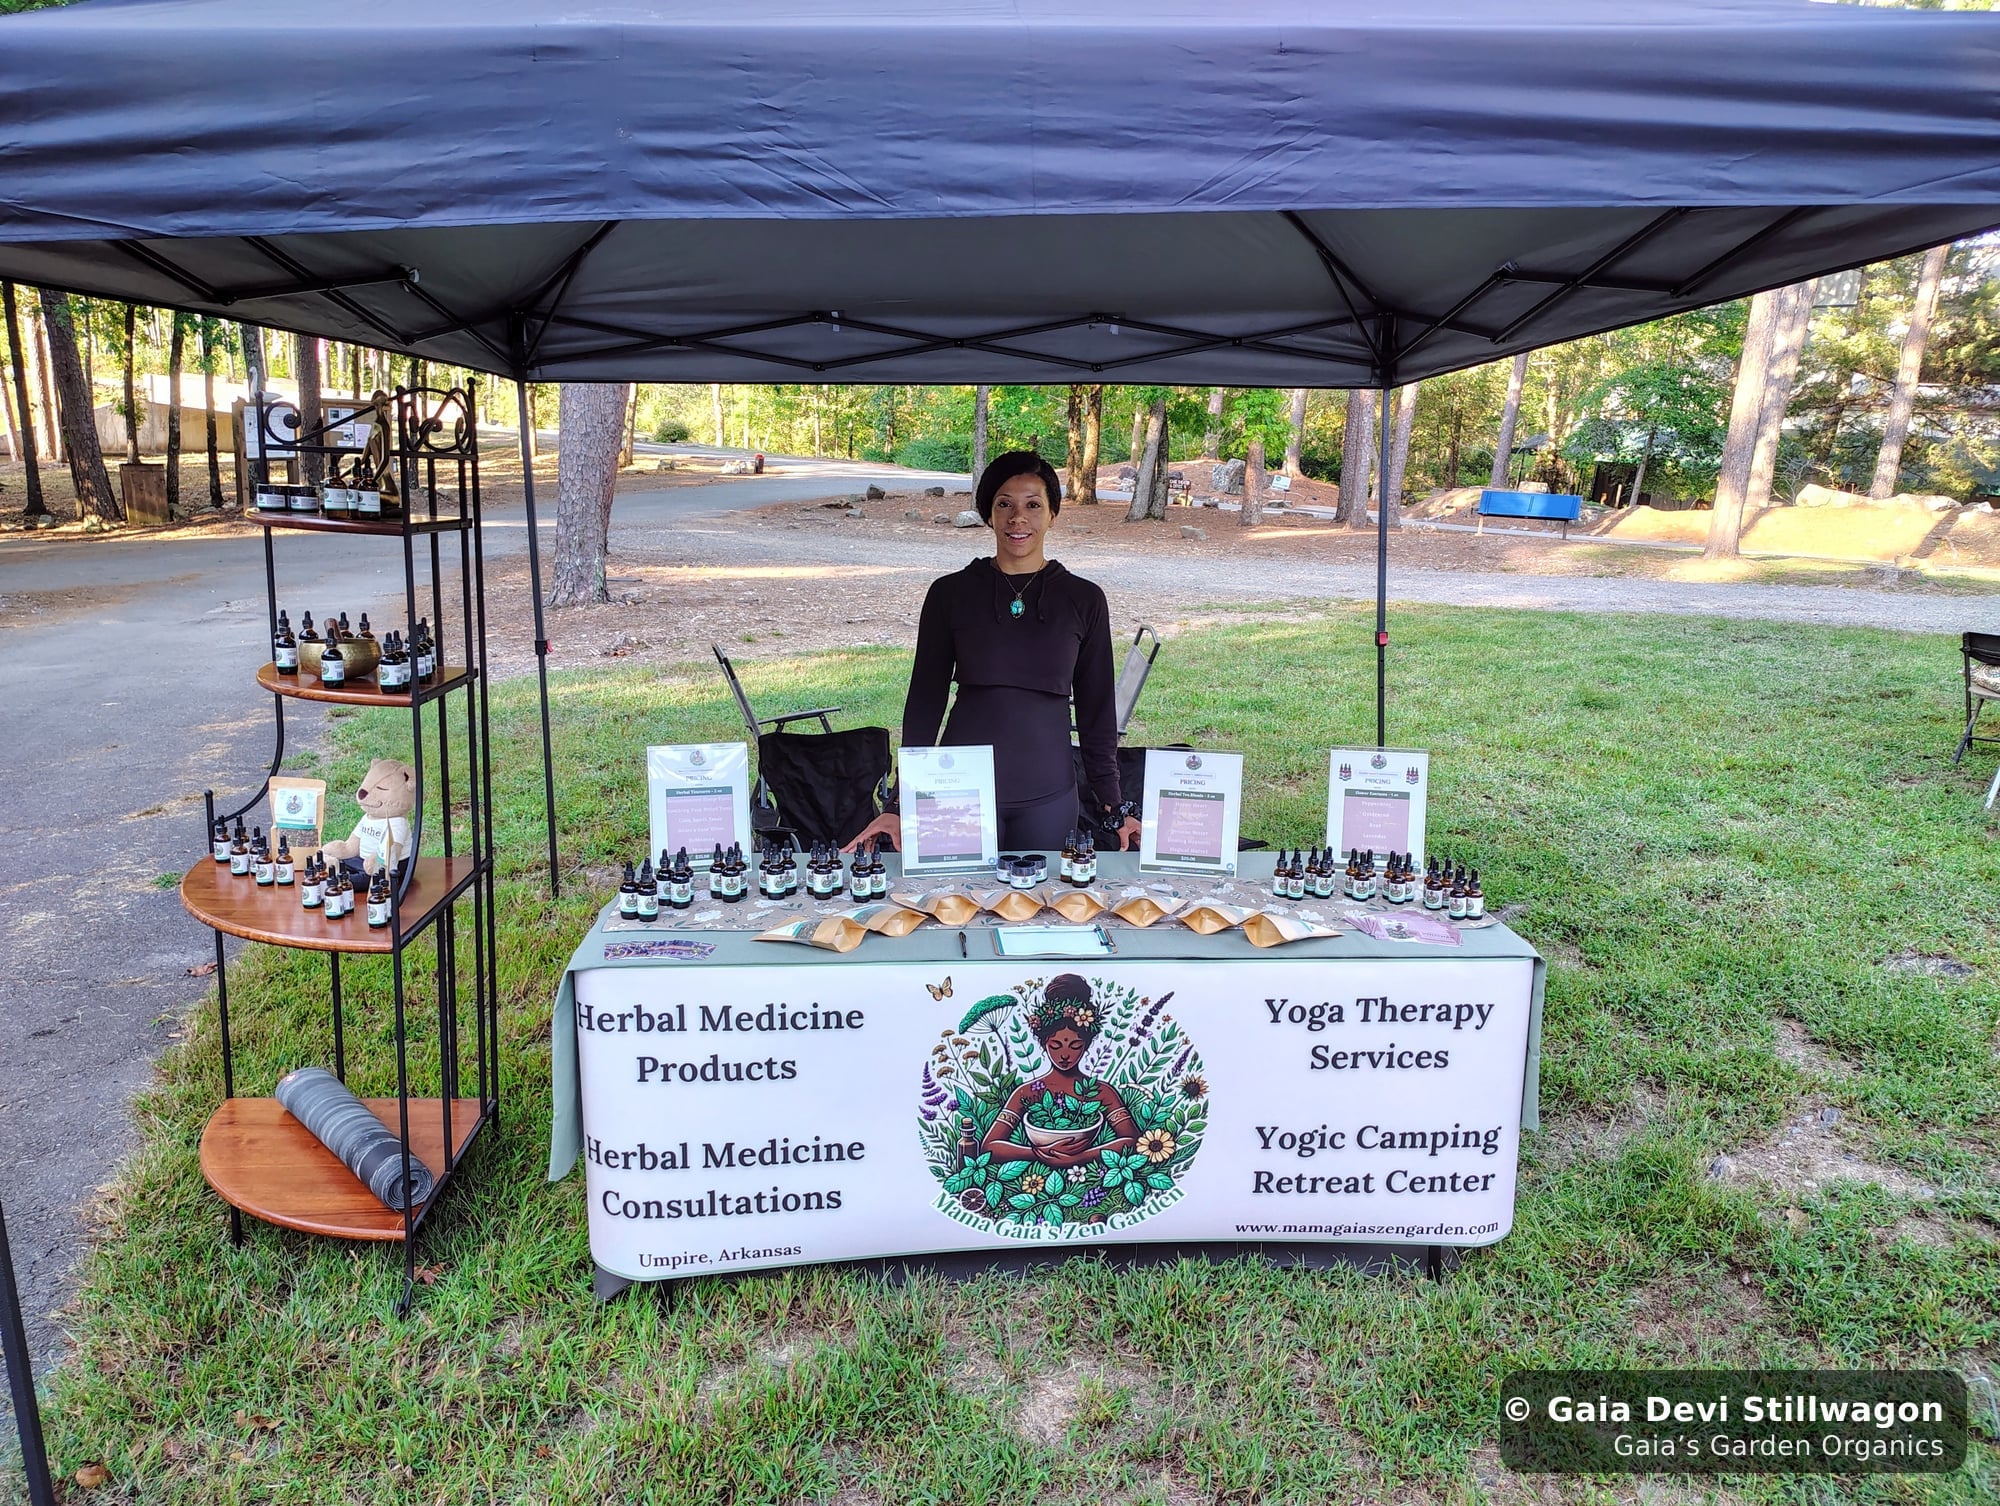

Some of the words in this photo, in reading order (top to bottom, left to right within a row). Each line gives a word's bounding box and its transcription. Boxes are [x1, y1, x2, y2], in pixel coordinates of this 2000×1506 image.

[576, 1001, 687, 1032] Herbal
[699, 1002, 865, 1032] Medicine
[1264, 998, 1345, 1032] Yoga
[1355, 996, 1495, 1031] Therapy
[636, 1053, 798, 1083] Products
[1310, 1042, 1449, 1070] Services
[586, 1133, 690, 1171] Herbal
[702, 1135, 866, 1169] Medicine
[1255, 1123, 1346, 1158] Yogic
[1356, 1122, 1502, 1157] Camping
[1252, 1169, 1376, 1194] Retreat
[1385, 1168, 1496, 1194] Center
[602, 1185, 843, 1220] Consultations
[932, 1191, 992, 1234] Mama
[996, 1220, 1059, 1240] Gaia's
[1063, 1221, 1106, 1240] Zen
[1109, 1186, 1186, 1232] Garden
[1235, 1219, 1499, 1238] www.mamagaiaszengarden.com
[639, 1250, 713, 1270] Umpire,
[718, 1244, 802, 1263] Arkansas
